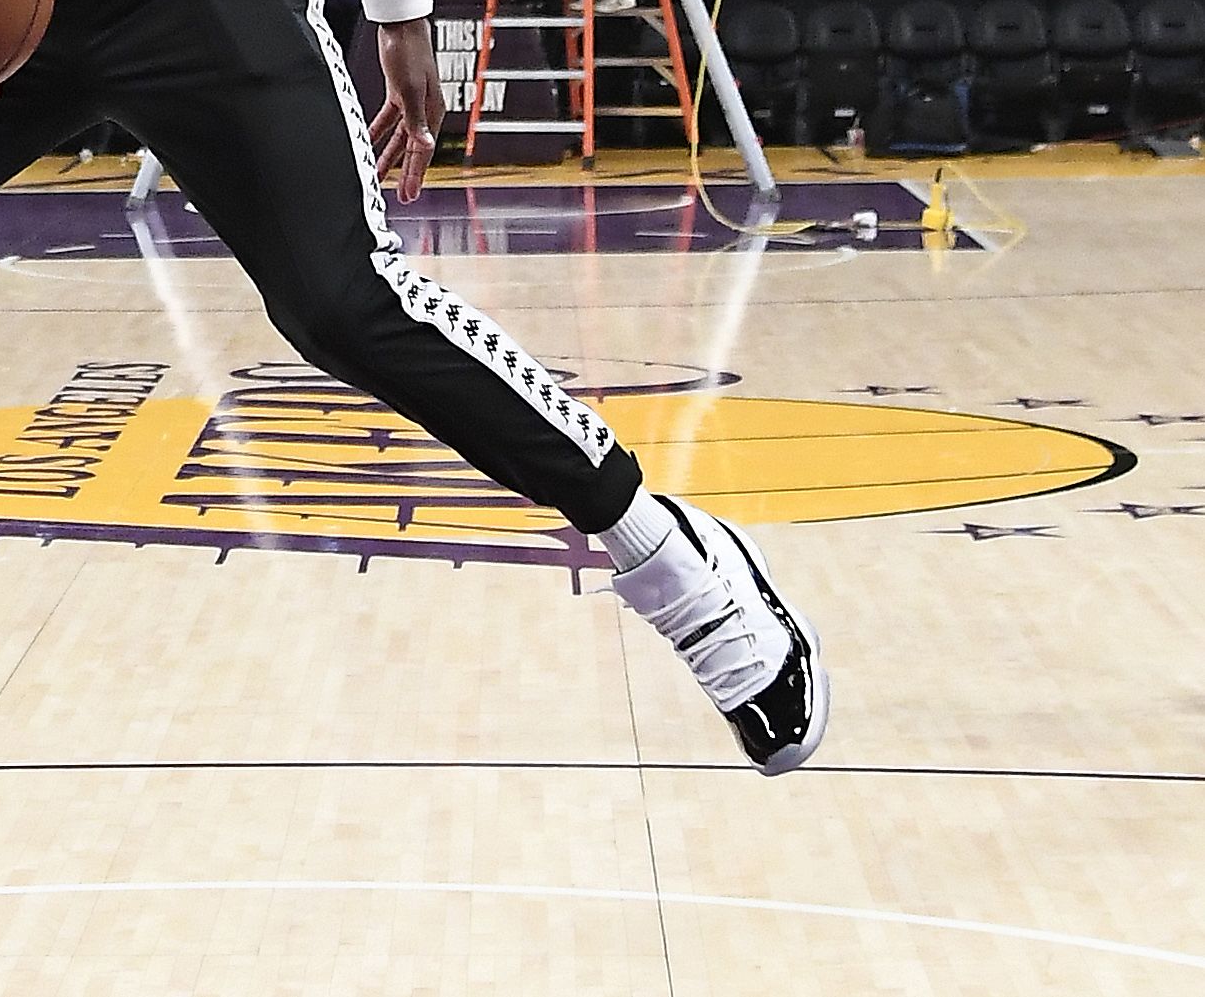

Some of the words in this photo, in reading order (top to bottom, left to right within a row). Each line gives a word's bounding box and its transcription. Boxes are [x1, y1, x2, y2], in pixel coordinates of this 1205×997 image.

[434, 20, 475, 51] THIS
[435, 51, 477, 81] WHY
[440, 81, 463, 112] WE
[463, 81, 507, 112] PAY
[14, 362, 172, 451] ANGELES
